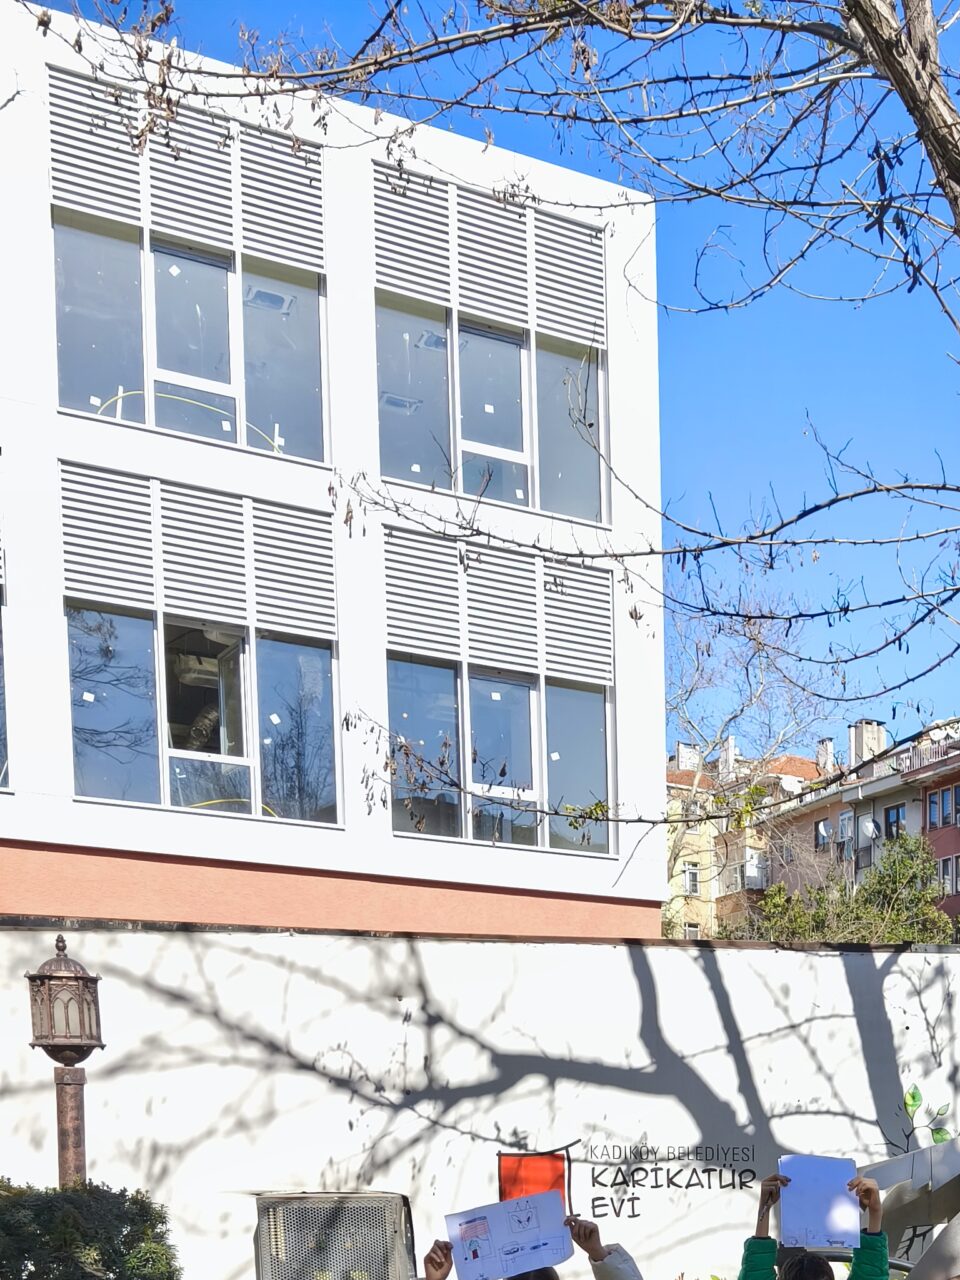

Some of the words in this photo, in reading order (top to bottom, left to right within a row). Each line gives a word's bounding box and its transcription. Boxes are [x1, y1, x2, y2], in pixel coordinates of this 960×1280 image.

[590, 1142, 660, 1160] KADIKÖY
[667, 1144, 756, 1162] BELEDİYESİ
[590, 1163, 758, 1190] KARİKATÜR
[590, 1192, 642, 1219] EVİ
